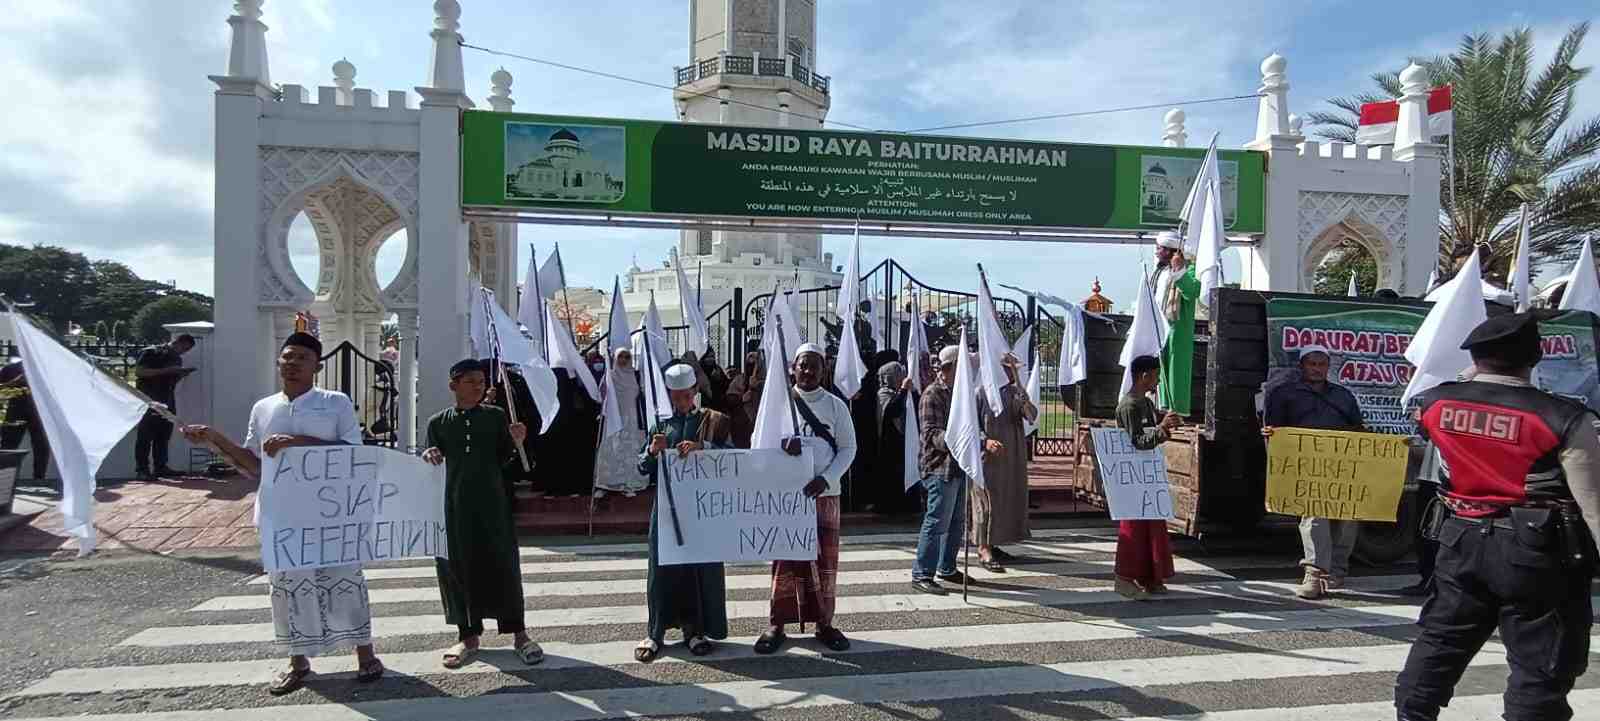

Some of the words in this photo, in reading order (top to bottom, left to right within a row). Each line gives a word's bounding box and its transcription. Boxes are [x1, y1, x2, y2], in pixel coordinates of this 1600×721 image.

[707, 131, 800, 153] MASJID
[808, 136, 873, 157] RAYA
[880, 140, 1067, 167] BAITURRAHMAN
[742, 163, 768, 171] ANDA
[771, 164, 819, 173] MEMASUKI
[821, 167, 865, 175] KAWASAN
[867, 169, 896, 177] WAJIB
[898, 170, 951, 178] BERBUSANA
[952, 172, 985, 180] MUSLIM
[993, 175, 1037, 183] MUSLIMAH
[868, 161, 919, 170] PERHATIAN:
[760, 180, 792, 191] المنطقة
[795, 182, 815, 192] هذه
[818, 184, 831, 198] في
[1009, 190, 1016, 201] لا
[746, 202, 766, 210] YOU
[768, 203, 786, 211] ARE
[788, 204, 811, 212] NOW
[909, 209, 954, 217] MUSLIMAH
[956, 210, 984, 218] DRESS
[985, 212, 1008, 220] ONLY
[867, 200, 918, 208] ATTENTION:
[1282, 326, 1382, 353] DARURAT
[1339, 361, 1394, 384] ATAU
[1440, 407, 1521, 441] POLISI
[1287, 433, 1404, 458] TETAPKAN
[273, 447, 377, 485] ACEH
[1270, 456, 1365, 479] DARURAT
[317, 482, 400, 519] SIAP
[1269, 496, 1363, 520] NASIONAL
